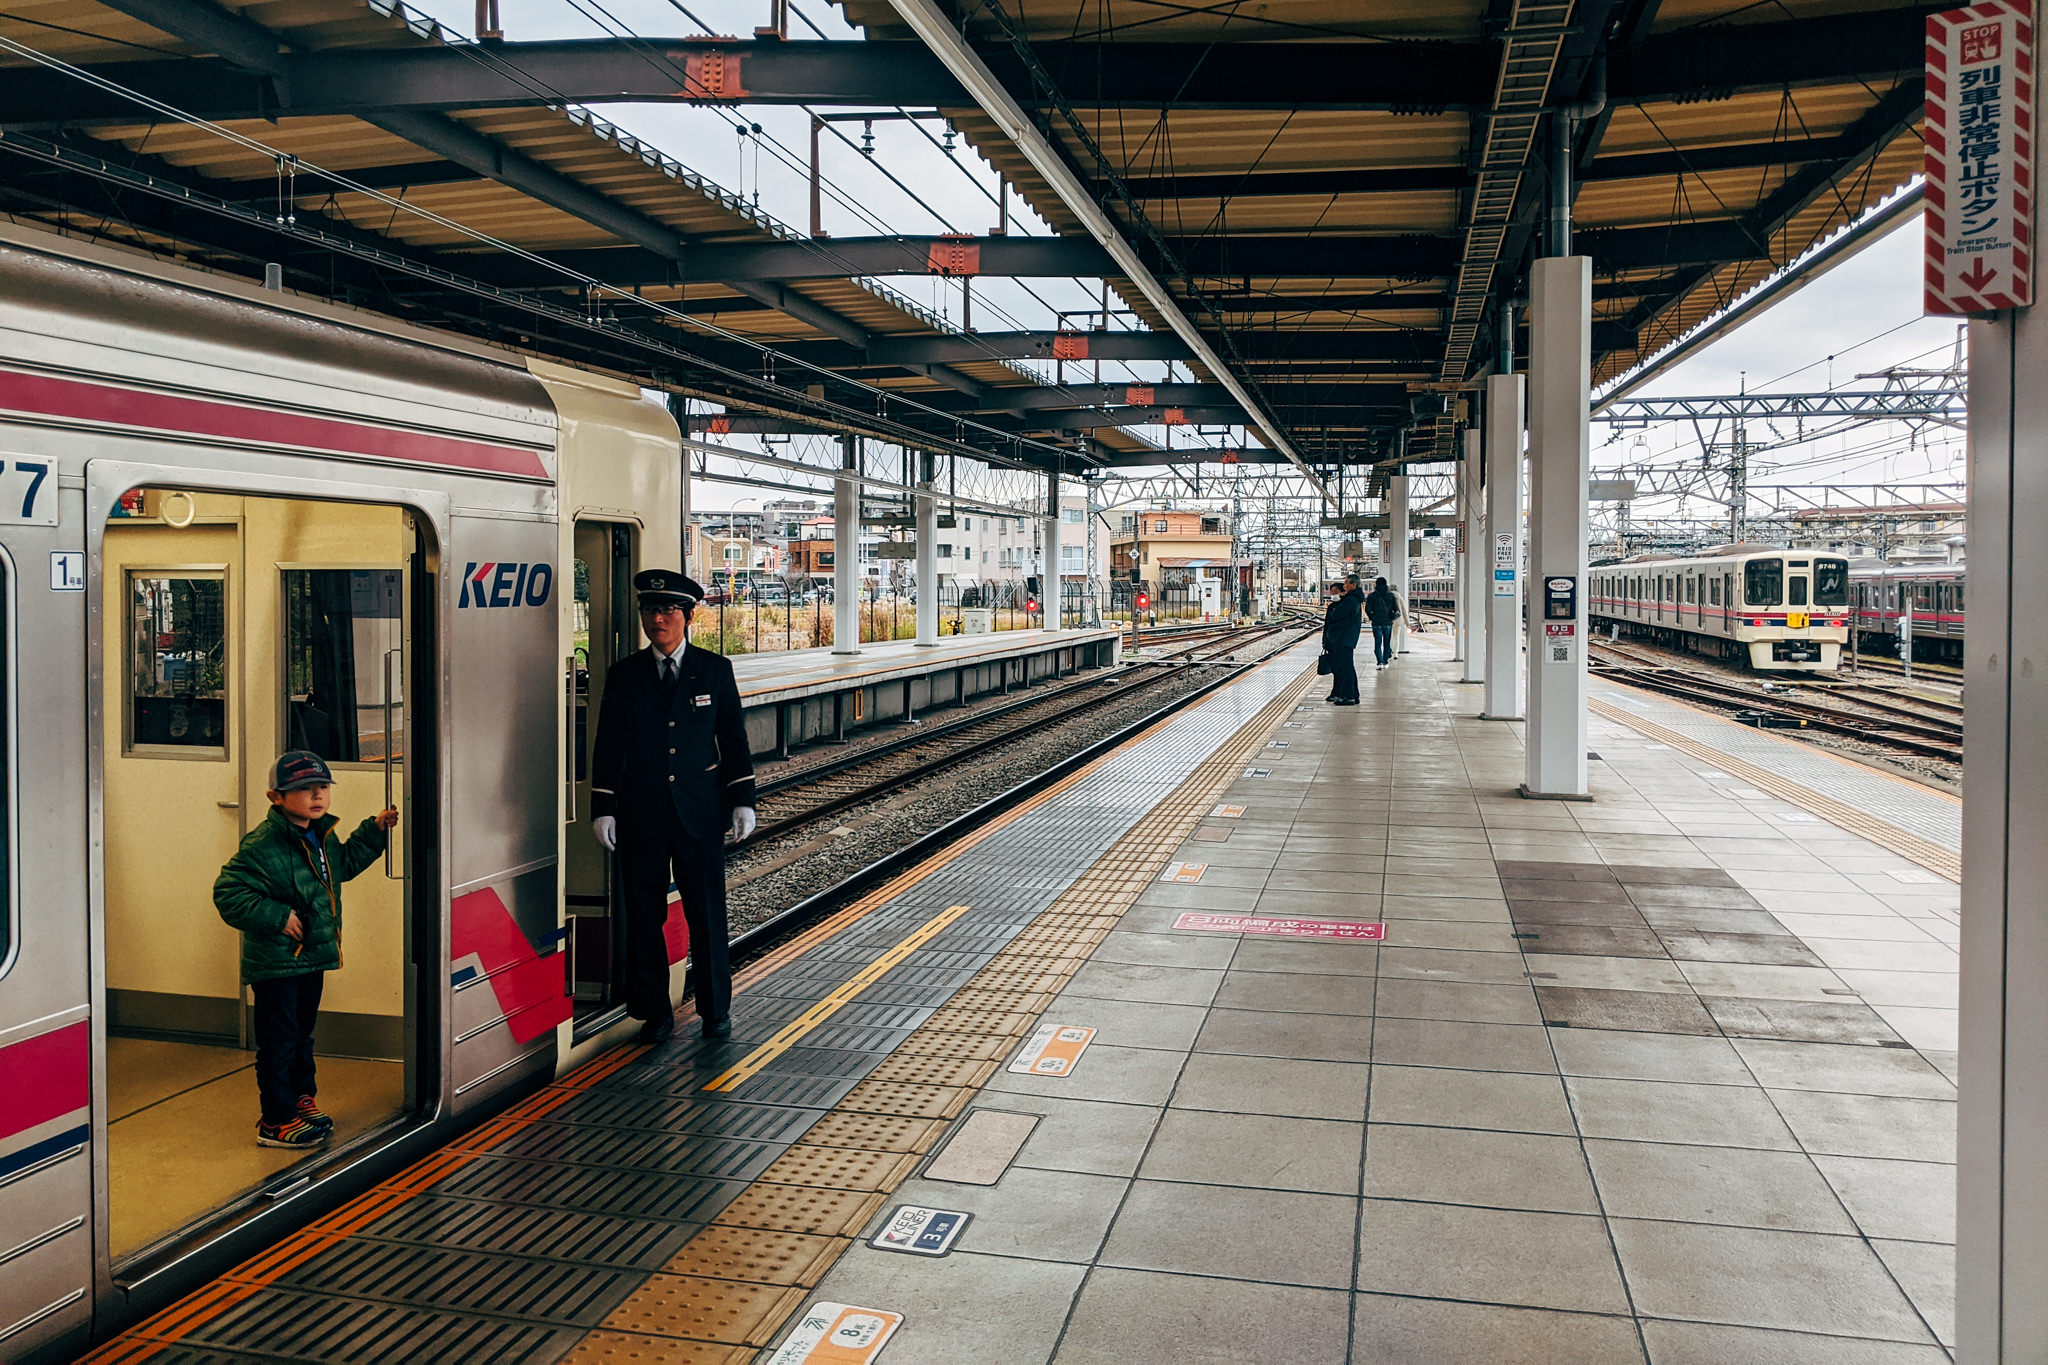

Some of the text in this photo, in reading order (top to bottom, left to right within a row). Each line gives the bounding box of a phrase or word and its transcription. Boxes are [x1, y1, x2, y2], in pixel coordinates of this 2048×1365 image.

[1963, 25, 1999, 41] STOP
[1958, 65, 2001, 235] 列車非常停止ボタン
[1946, 241, 2011, 256] Train Stop Button
[1956, 236, 1998, 247] Emergency
[0, 460, 48, 518] 7
[458, 562, 552, 609] KEIO
[891, 1210, 915, 1233] KEIO
[904, 1209, 931, 1236] LINER
